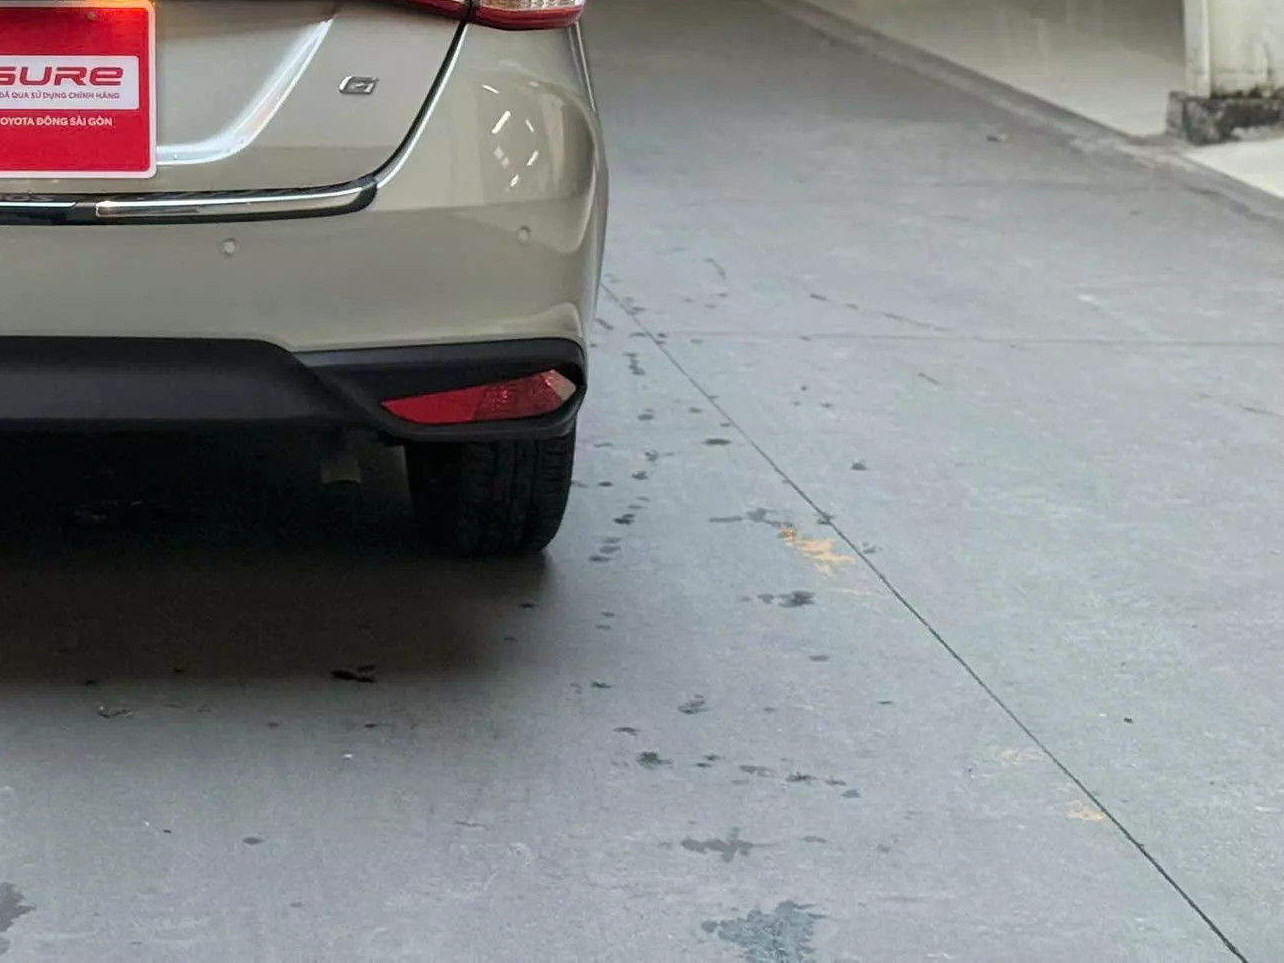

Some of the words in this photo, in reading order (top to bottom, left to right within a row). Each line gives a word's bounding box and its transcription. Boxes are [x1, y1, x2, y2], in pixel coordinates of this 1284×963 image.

[339, 75, 380, 95] G
[11, 92, 29, 100] QUA
[36, 115, 68, 126] ĐÔNG
[71, 114, 86, 126] SÀI
[88, 115, 113, 126] GÒN
